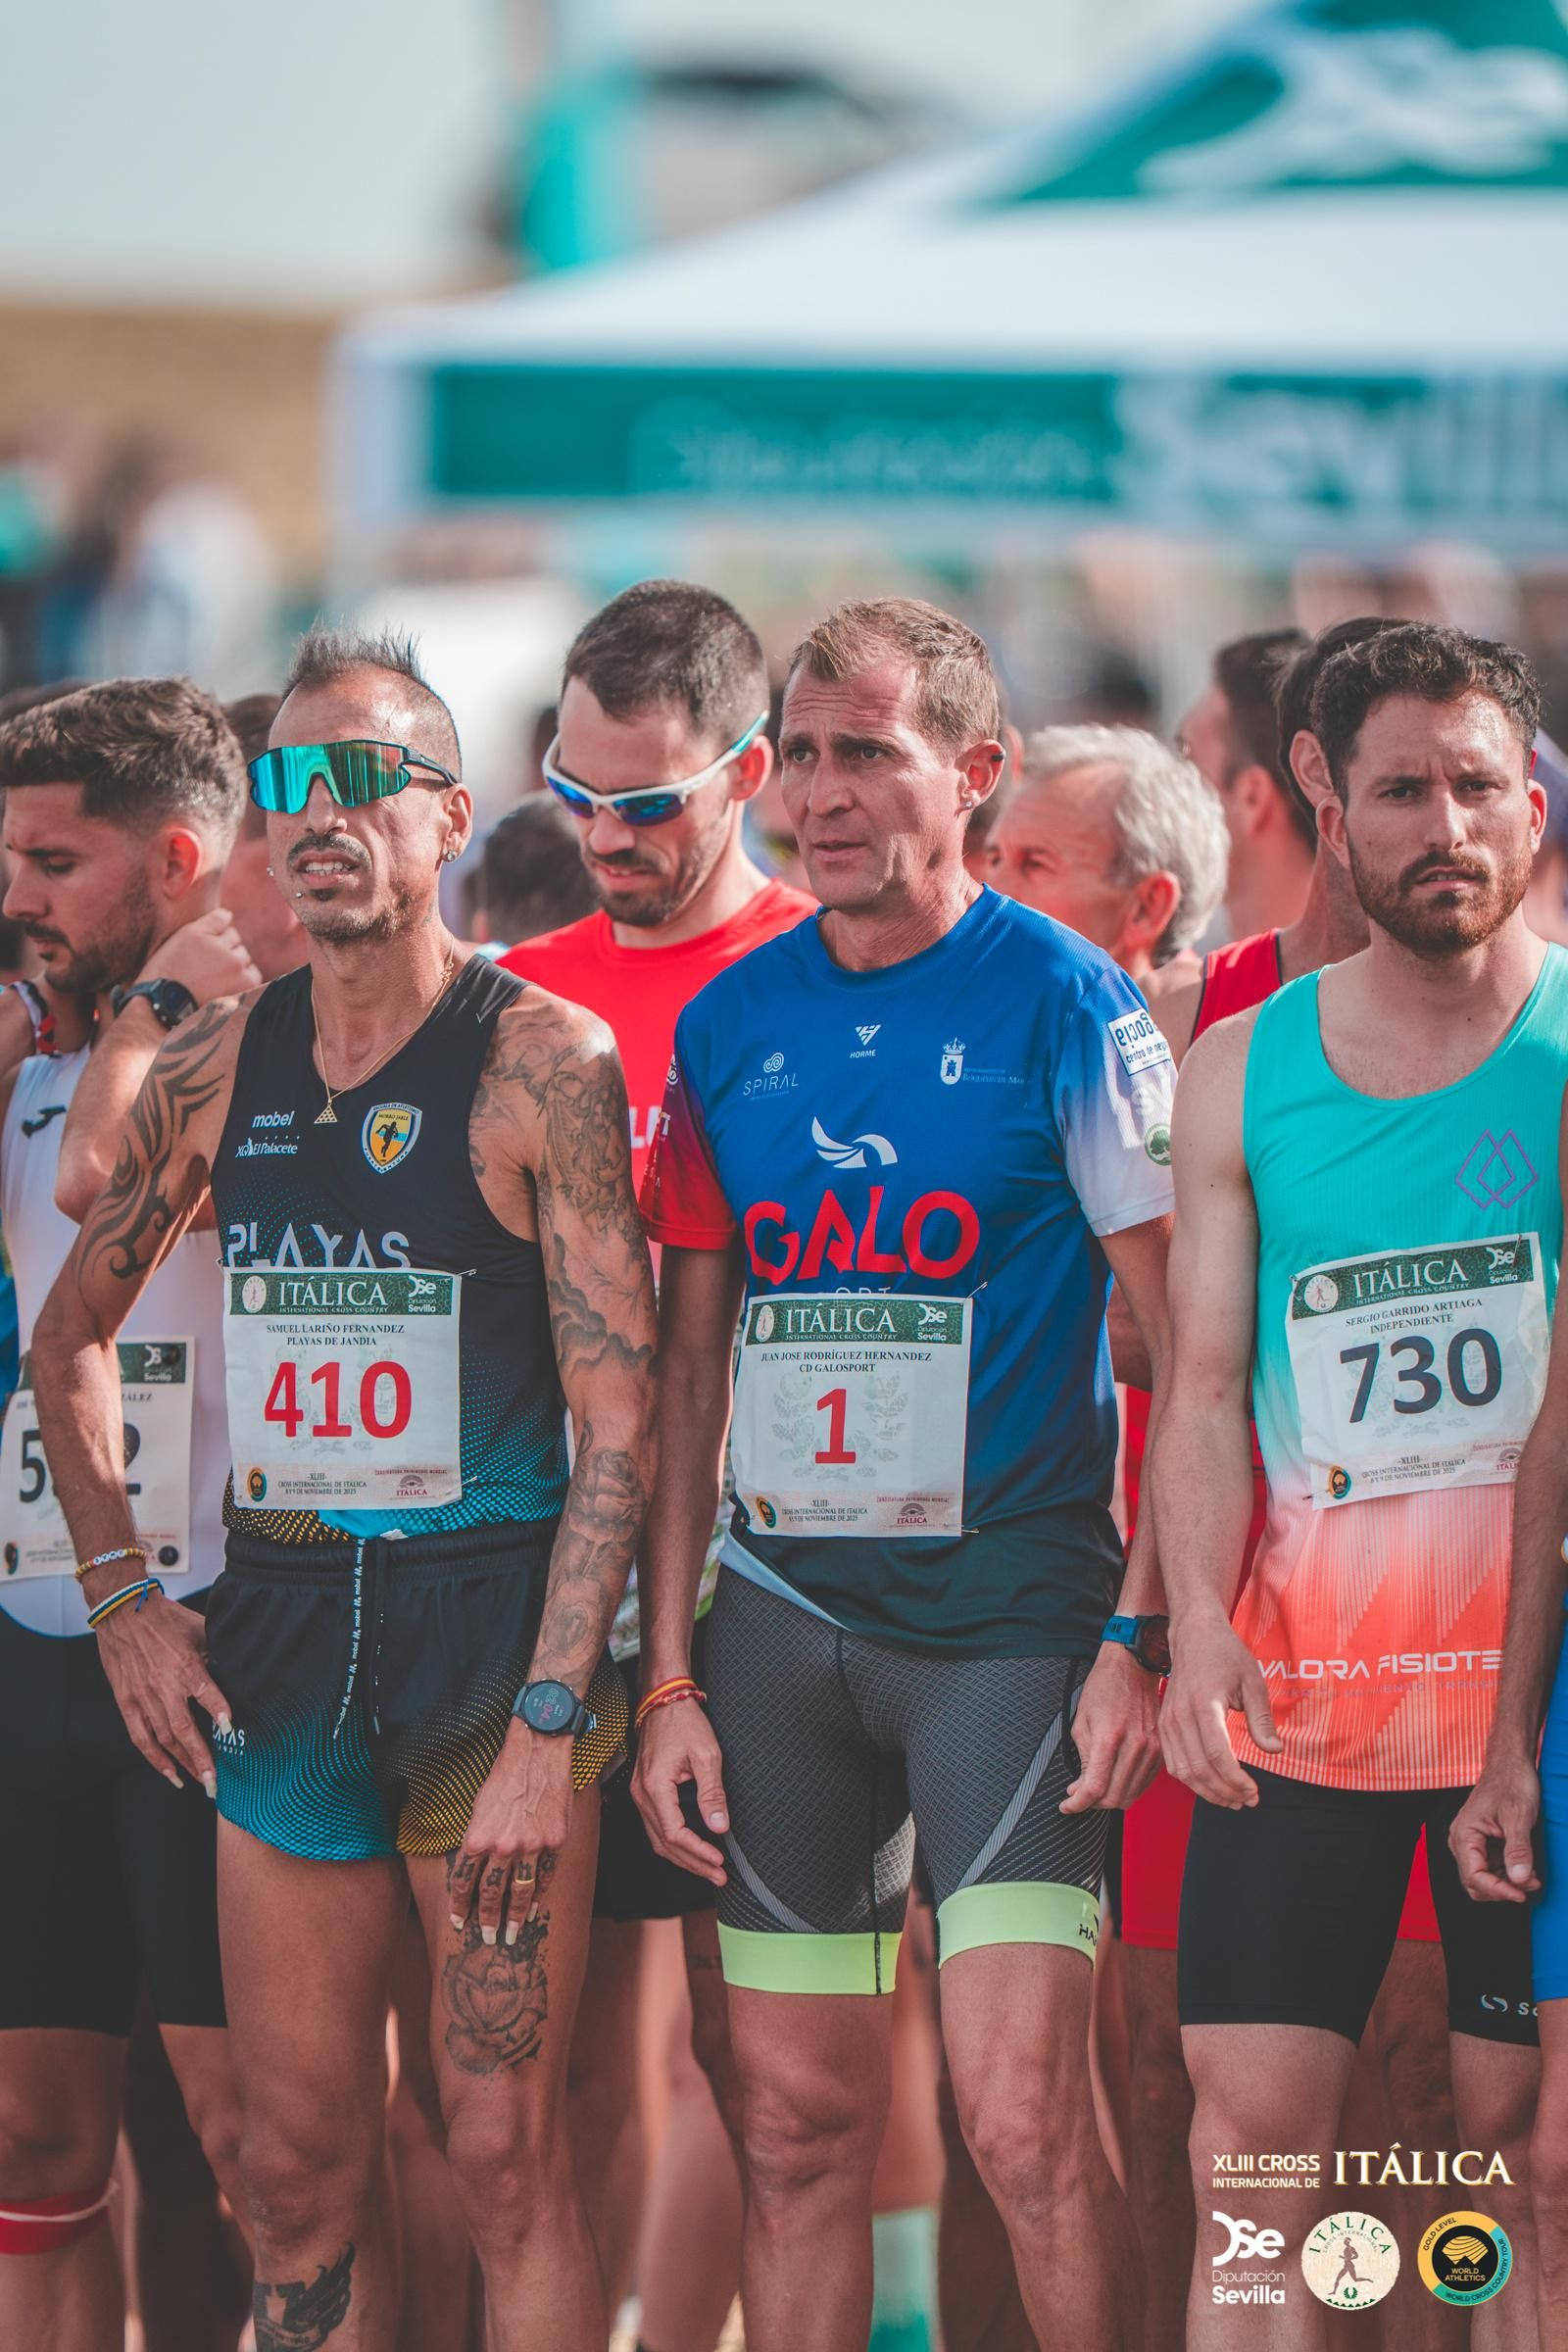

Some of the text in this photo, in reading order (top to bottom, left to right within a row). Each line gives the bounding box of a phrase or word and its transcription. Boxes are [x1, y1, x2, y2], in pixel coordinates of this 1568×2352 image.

[850, 1050, 877, 1058] HORME
[743, 1073, 800, 1096] SPIRAL
[252, 1110, 295, 1128] mobel
[260, 1143, 298, 1154] Palacete
[228, 1222, 412, 1268] PLAYAS
[744, 1186, 980, 1286] GALO
[1353, 1259, 1469, 1298] ITÁLICA
[1490, 1275, 1518, 1285] Sevilla
[279, 1276, 388, 1306] ITÁLICA
[1356, 1290, 1405, 1305] INTERNATIONAL
[1434, 1284, 1470, 1293] COUNTRY
[408, 1304, 436, 1313] Sevilla
[786, 1302, 897, 1333] ITÁLICA
[1346, 1298, 1482, 1327] SERGIO GARRIDO ARTIAGA
[267, 1323, 405, 1334] SAMUEL LARIÑO FERNANDEZ
[1371, 1314, 1453, 1333] INDEPENDIENTE
[287, 1337, 377, 1346] PLAYAS DE JANDIA
[917, 1333, 947, 1342] Sevilla
[760, 1348, 932, 1361] JUAN JOSE RODRÍGUEZ HERNANDEZ
[800, 1363, 876, 1373] CD GALOSPORT
[1341, 1328, 1502, 1423] 730
[265, 1361, 412, 1439] 410
[815, 1389, 857, 1464] 1
[1380, 1463, 1432, 1475] INTERNACIONAL
[1257, 1650, 1503, 1680] VALORA FISIOTE
